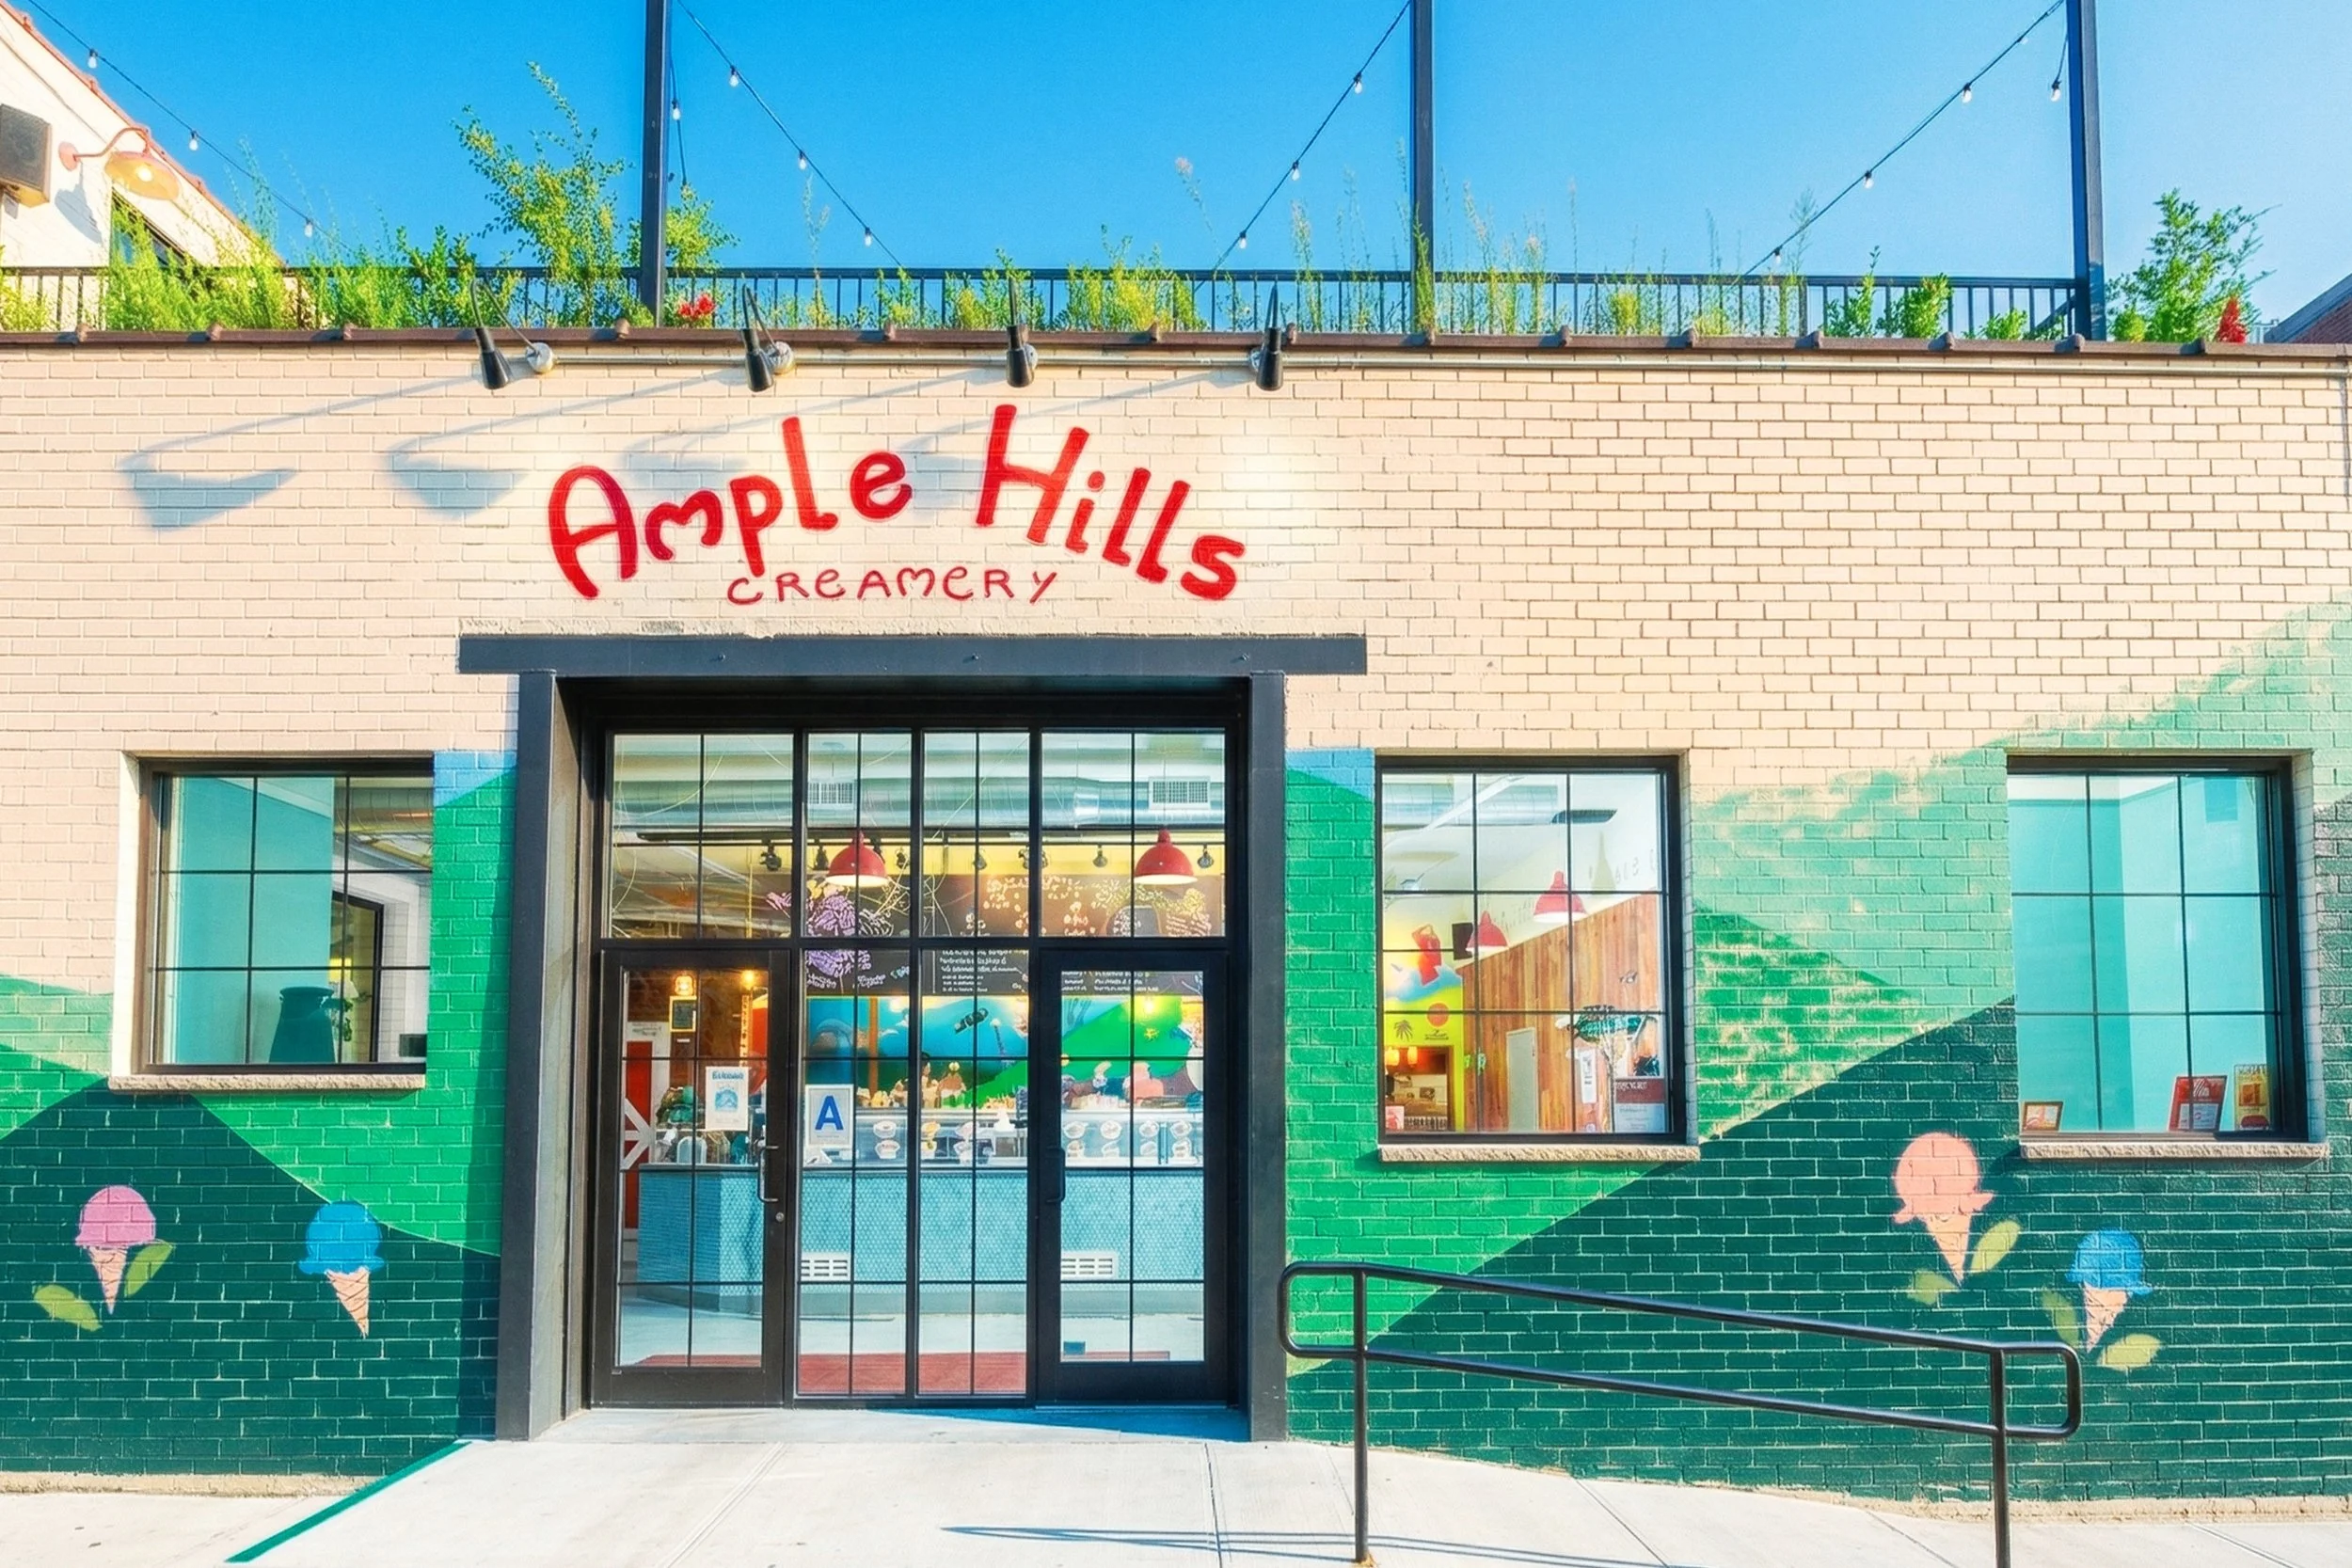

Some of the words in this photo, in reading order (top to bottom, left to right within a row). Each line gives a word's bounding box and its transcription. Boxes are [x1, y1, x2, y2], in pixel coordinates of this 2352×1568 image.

[548, 416, 914, 602] Ample
[974, 403, 1247, 602] Hills
[815, 1095, 844, 1131] A
